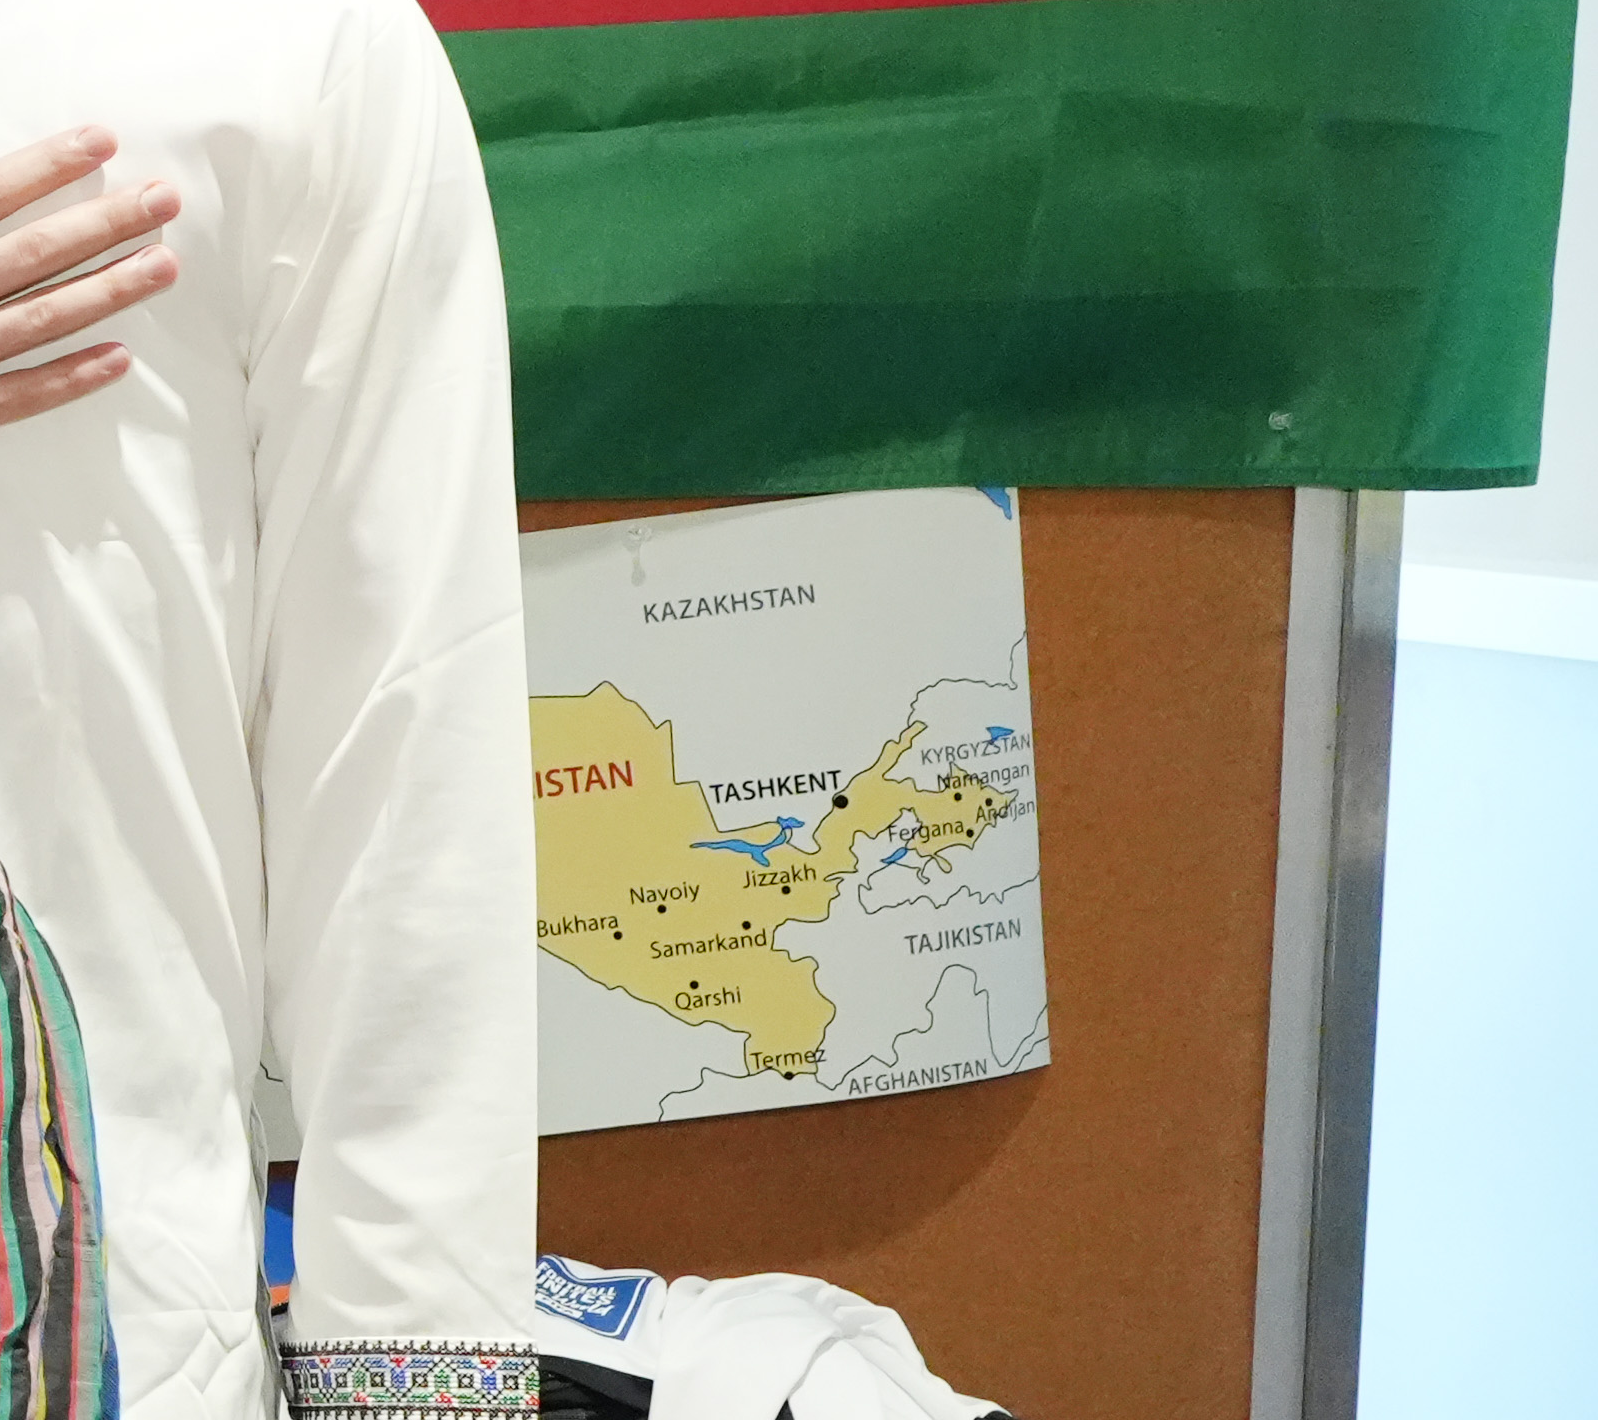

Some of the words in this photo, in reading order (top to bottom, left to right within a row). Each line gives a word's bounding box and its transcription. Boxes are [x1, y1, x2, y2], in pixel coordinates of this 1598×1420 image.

[643, 584, 815, 623] KAZAKHSTAN
[921, 734, 1030, 765] KYRGYZSTAN
[534, 760, 633, 799] ISTAN
[709, 770, 842, 804] TASHKENT
[937, 764, 1030, 791] Namangan
[975, 799, 1035, 824] Andijan
[888, 821, 964, 843] Fergana
[742, 864, 817, 888] Jizzakh
[630, 882, 700, 905] Navoiy
[537, 915, 618, 938] Bukhara
[904, 918, 1022, 955] TAJIKISTAN
[650, 928, 767, 959] Samarkand
[675, 986, 742, 1011] Qarshi
[750, 1049, 827, 1070] Termez
[849, 1058, 989, 1096] AFGHANISTAN
[535, 1261, 617, 1297] FOOTBALL
